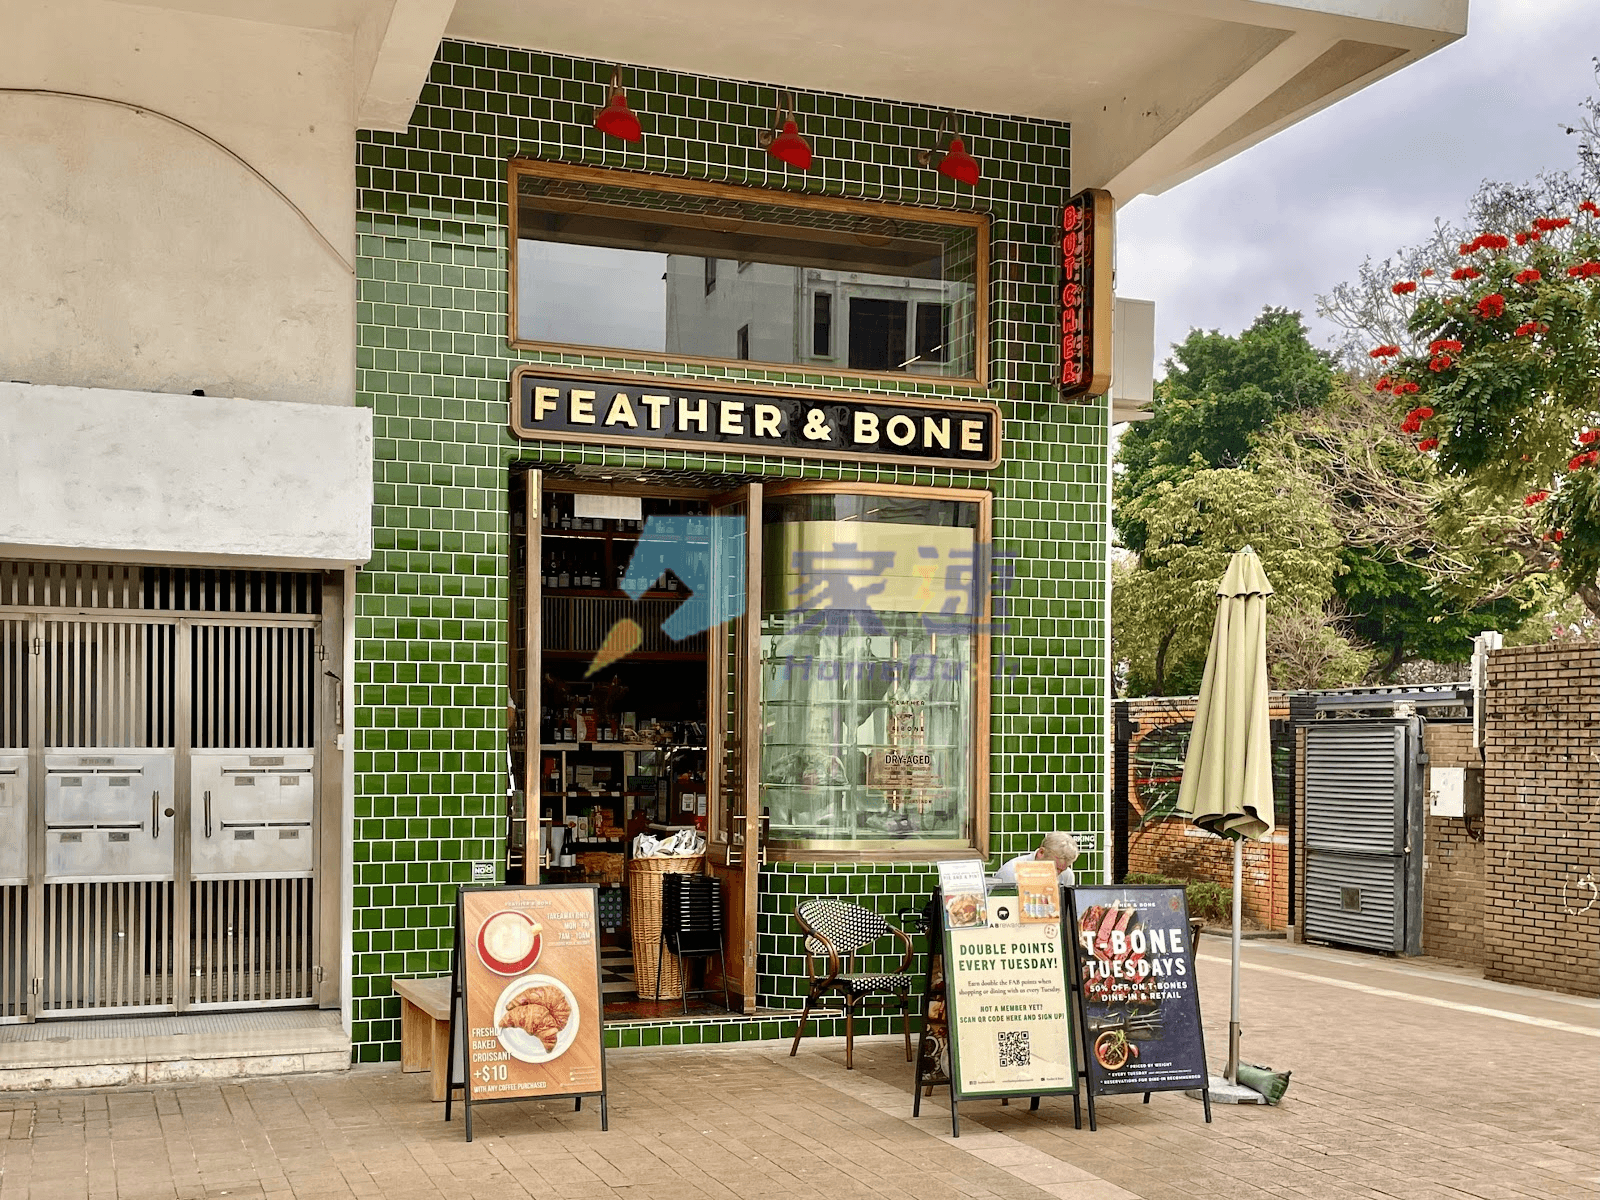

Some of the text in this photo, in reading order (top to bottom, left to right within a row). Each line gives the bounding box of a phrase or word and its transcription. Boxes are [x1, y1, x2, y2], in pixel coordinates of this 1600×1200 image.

[1063, 205, 1076, 384] BUTCHER
[533, 386, 984, 452] FEATHER & BONE
[885, 755, 930, 764] DRY-AGED
[1082, 928, 1184, 955] T-BONE
[959, 942, 1055, 956] DOUBLE POINTS
[959, 957, 1058, 971] EVERY TUESDAY!
[1086, 957, 1187, 978] TUESDAYS
[981, 979, 998, 987] double
[1021, 979, 1037, 987] points
[1090, 981, 1188, 992] 50% OFF ON T-BONES
[959, 988, 982, 996] shopping
[990, 987, 1006, 995] dining
[1007, 986, 1019, 994] with
[1026, 987, 1040, 995] every
[1101, 993, 1138, 1002] DINE-IN
[1150, 991, 1182, 999] RETAIL
[1000, 1004, 1027, 1012] MEMBER
[1028, 1003, 1043, 1011] YET?
[1006, 1014, 1022, 1022] HERE
[1037, 1013, 1053, 1021] SIGN
[472, 1040, 496, 1050] BAKED
[472, 1051, 512, 1062] CROISSANT
[473, 1064, 508, 1083] +$10
[473, 1081, 547, 1093] WITH ANY COFFEE PURCHASED
